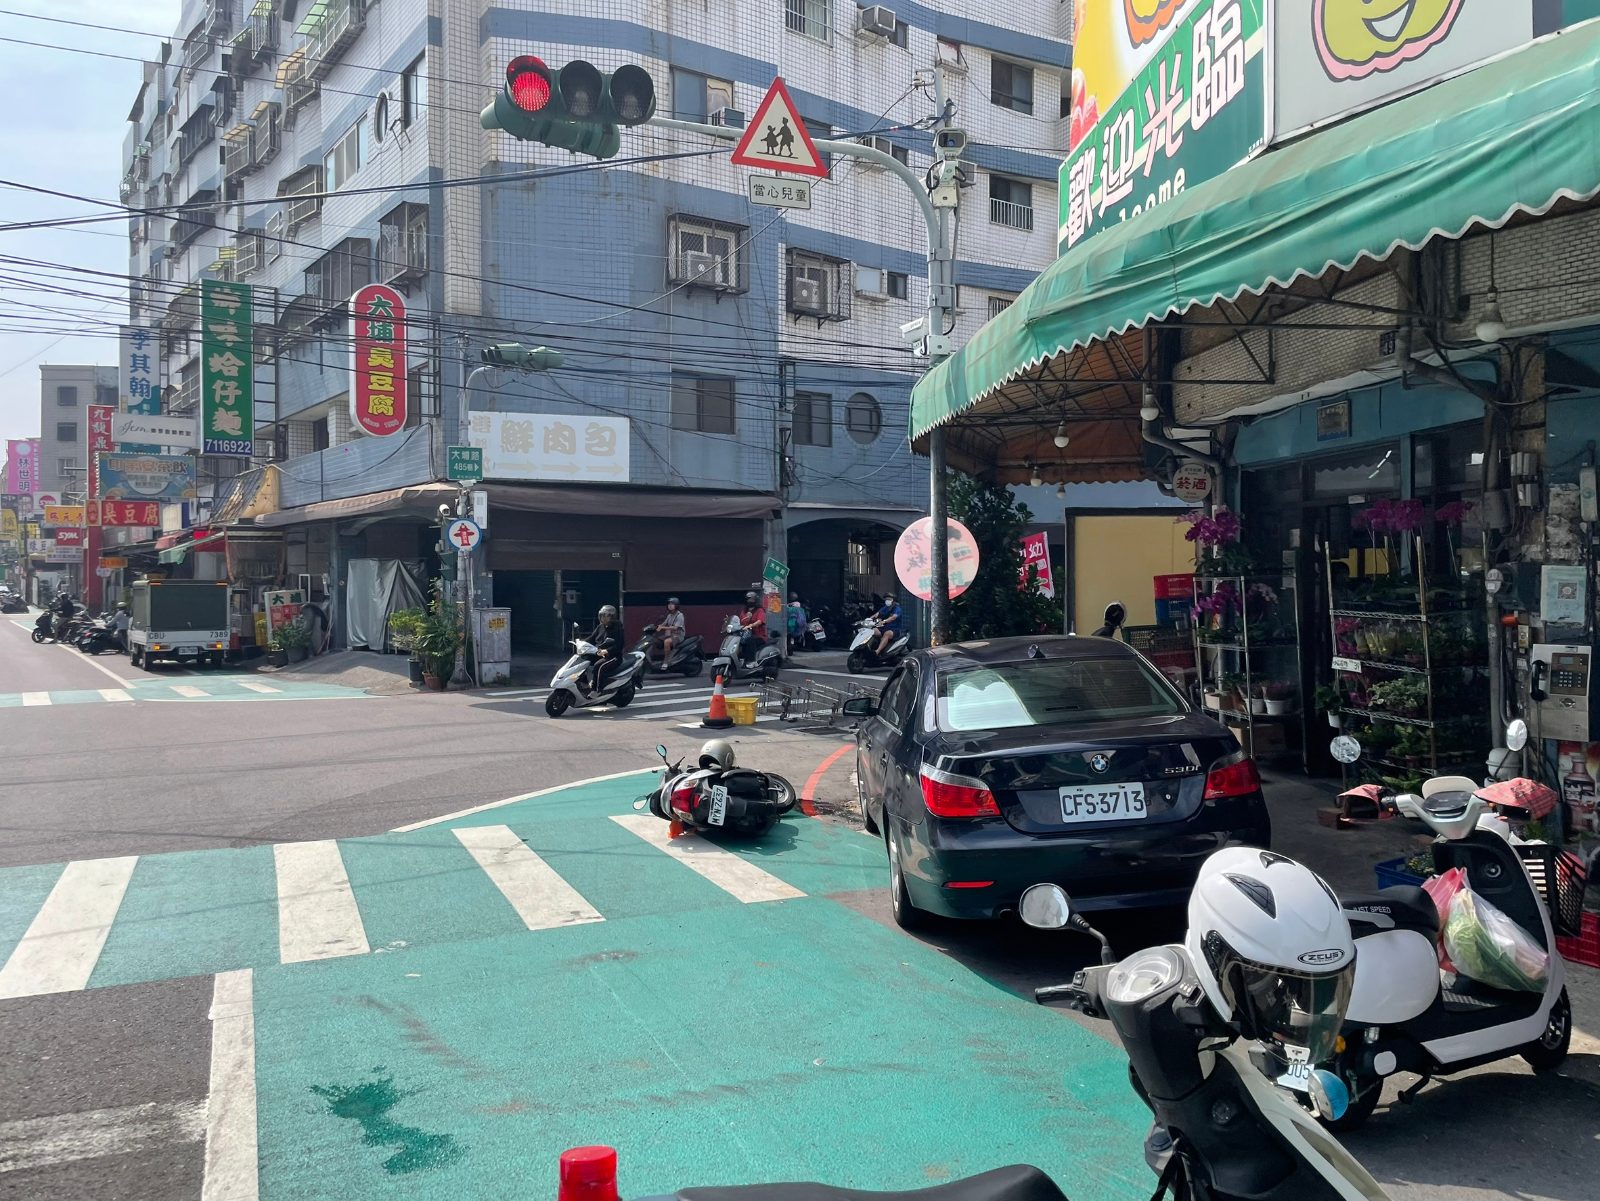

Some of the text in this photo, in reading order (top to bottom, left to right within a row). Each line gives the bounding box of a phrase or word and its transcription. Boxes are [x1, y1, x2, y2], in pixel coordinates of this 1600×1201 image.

[1067, 0, 1244, 248] 歡迎光臨
[753, 183, 807, 203] 當心兒童
[367, 294, 395, 416] 大埔臭豆腐
[205, 439, 251, 453] 7116922
[501, 419, 617, 456] 鮮肉包
[1176, 477, 1207, 490] 菸酒
[103, 502, 159, 525] 臭豆腐
[58, 532, 79, 541] SYM
[1308, 951, 1339, 960] ZEUS
